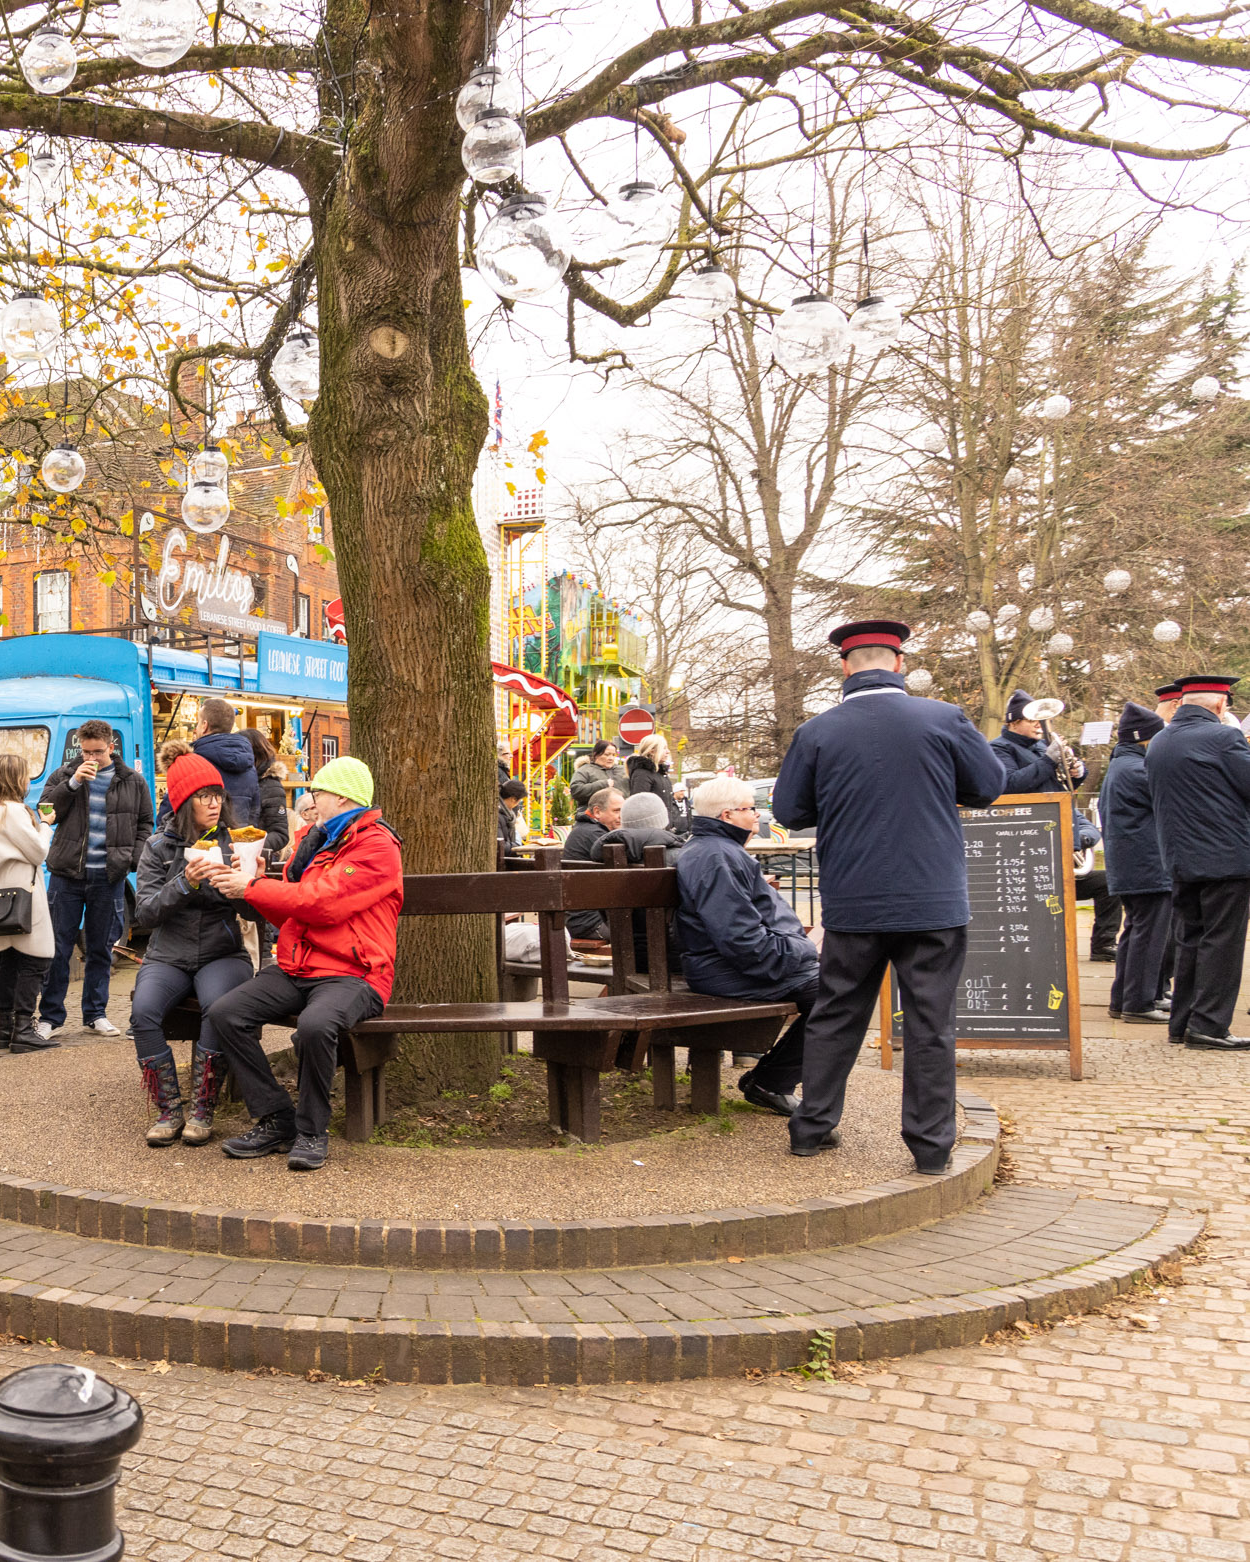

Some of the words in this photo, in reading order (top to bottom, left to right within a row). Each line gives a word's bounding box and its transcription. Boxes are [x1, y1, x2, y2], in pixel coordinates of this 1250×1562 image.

[200, 611, 227, 625] LEBANESE
[228, 617, 246, 629] STREET
[247, 621, 262, 632] FOOD
[268, 649, 301, 676] LEBANESE
[304, 656, 329, 680] STREET
[329, 660, 346, 683] FOOD
[963, 840, 983, 849] 2.20
[1003, 858, 1020, 867] 2.95
[965, 976, 993, 988] OUT
